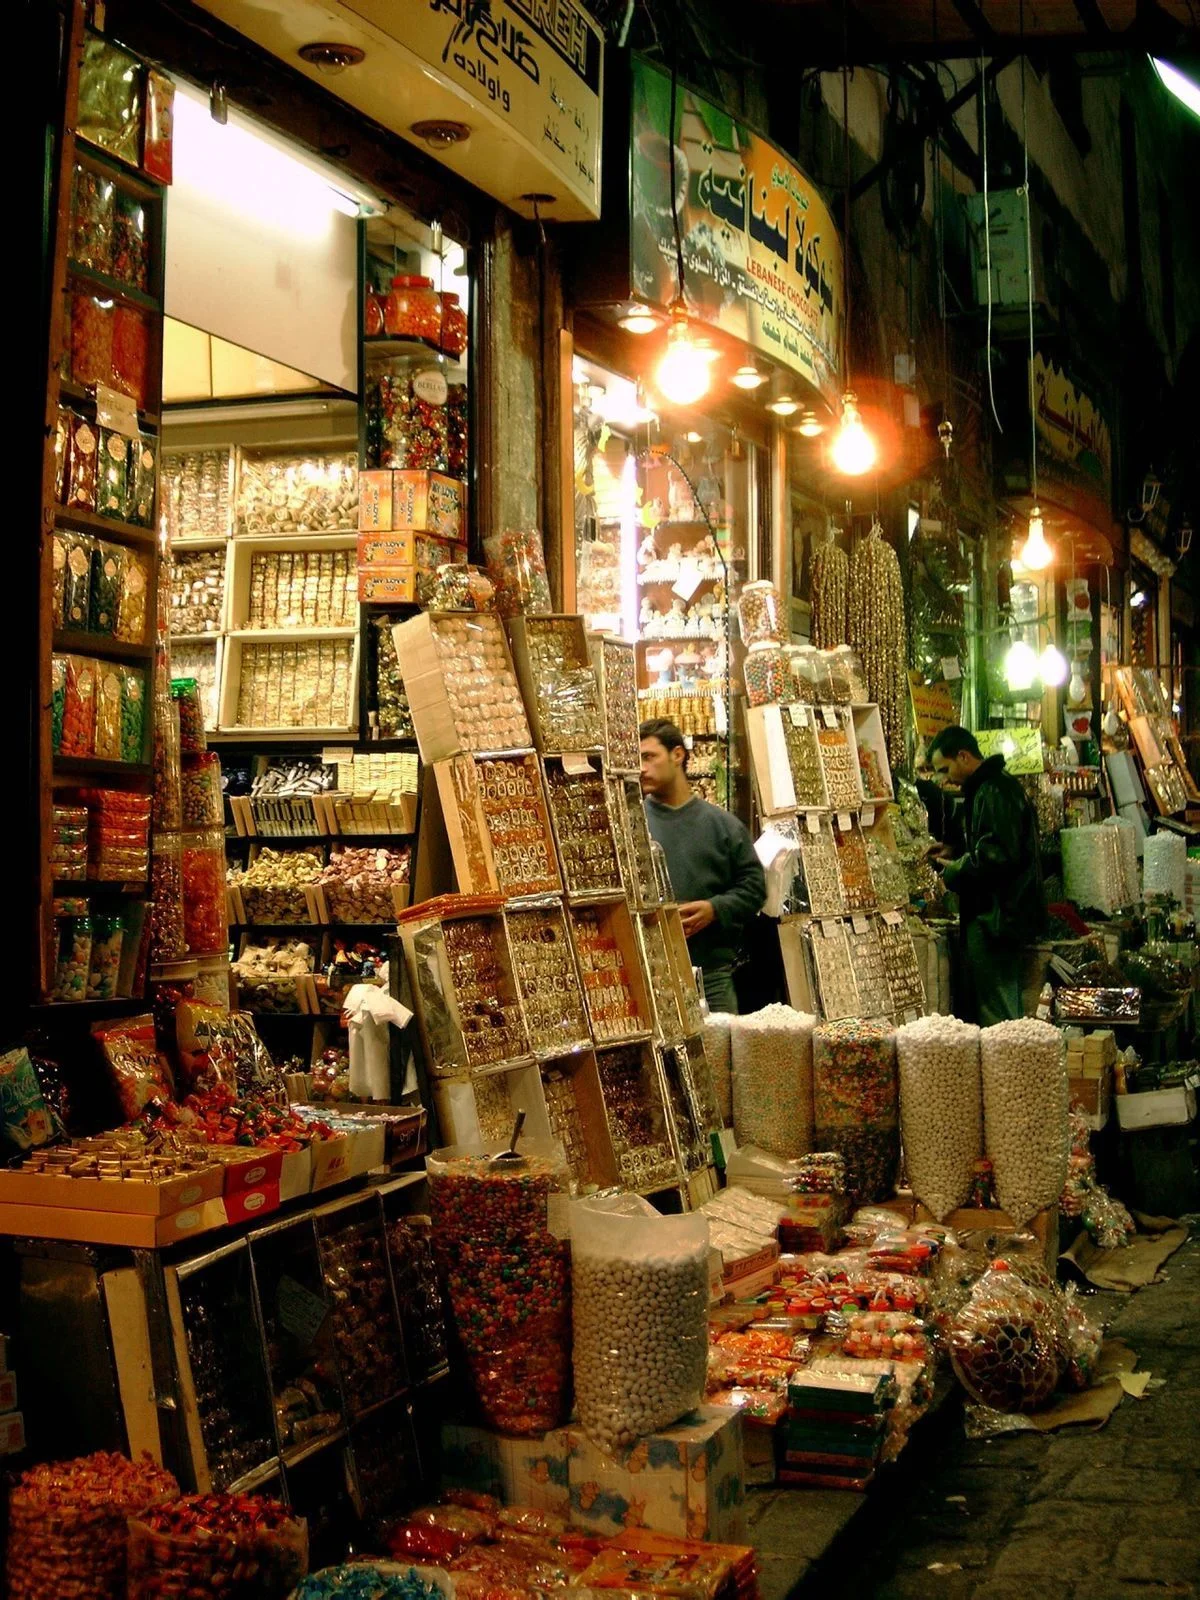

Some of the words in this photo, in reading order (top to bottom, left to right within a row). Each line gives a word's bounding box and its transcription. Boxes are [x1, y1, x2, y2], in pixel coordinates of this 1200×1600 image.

[453, 52, 511, 112] واولاده
[746, 256, 785, 296] LEBANESE
[787, 285, 820, 328] CHOCOLATE
[385, 541, 407, 549] LOVE
[385, 578, 408, 586] LOVE
